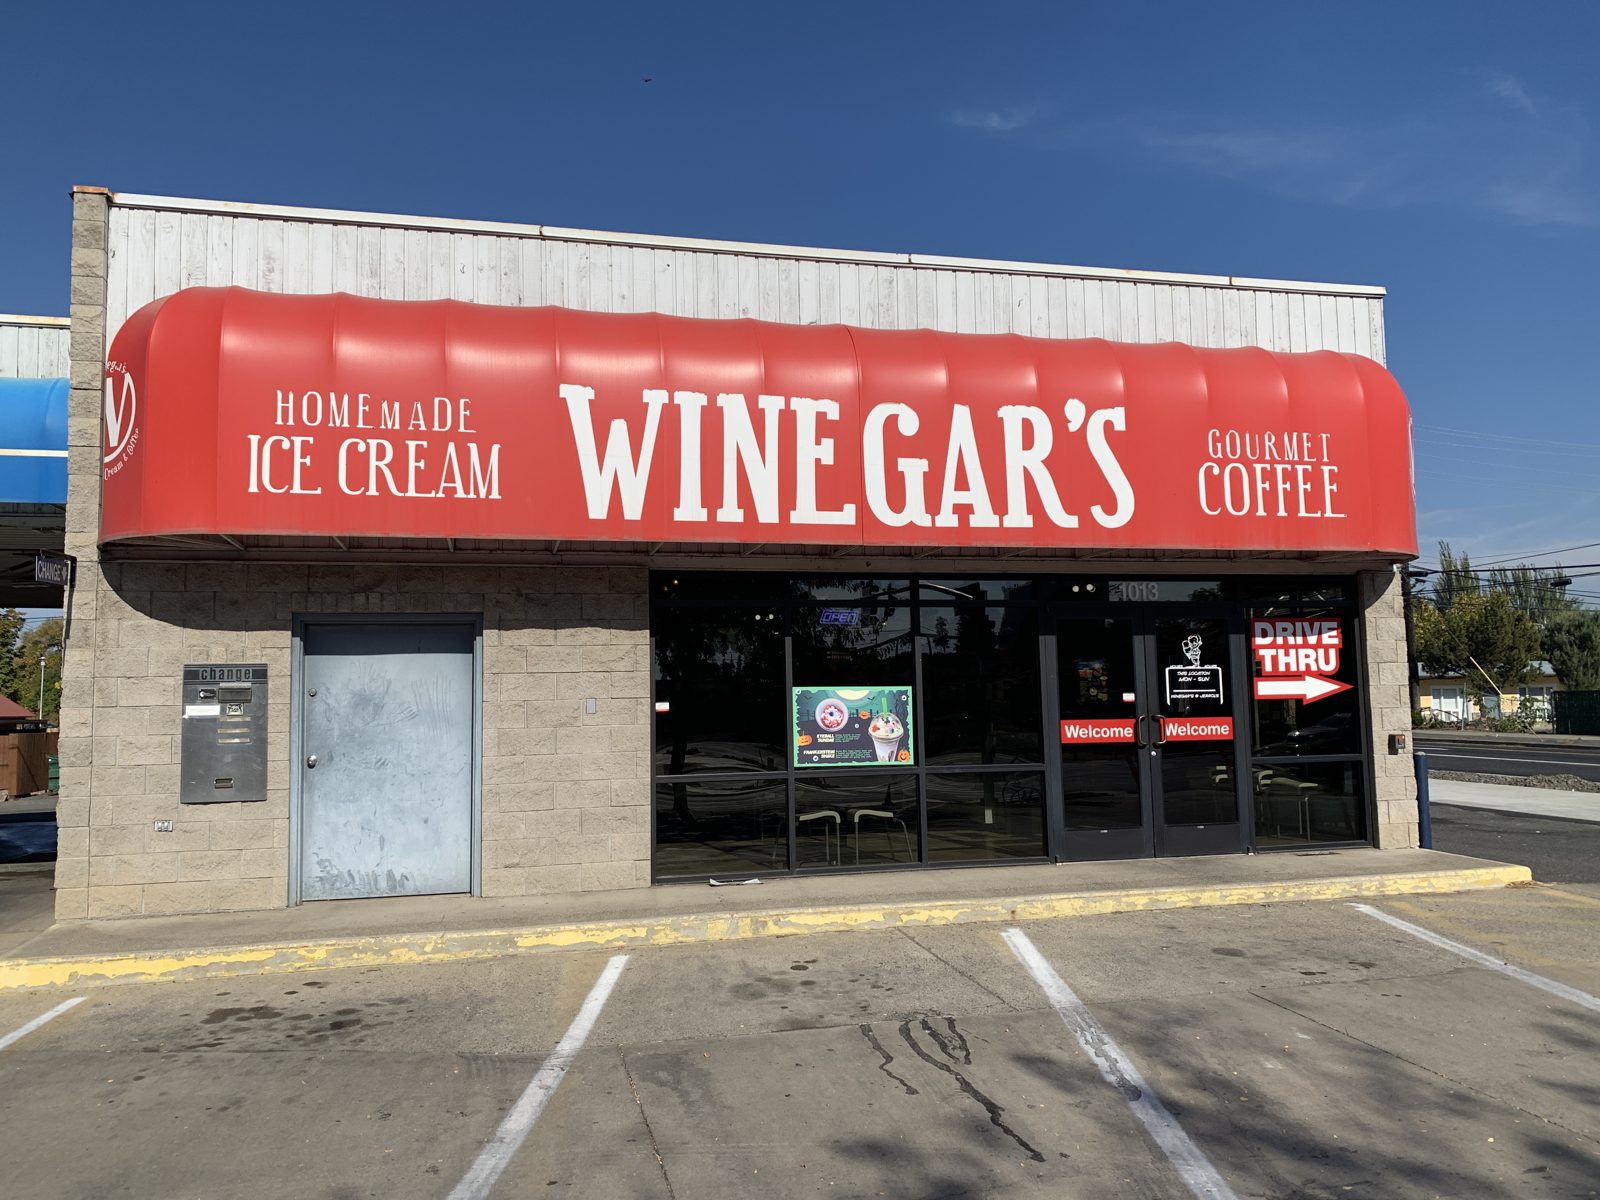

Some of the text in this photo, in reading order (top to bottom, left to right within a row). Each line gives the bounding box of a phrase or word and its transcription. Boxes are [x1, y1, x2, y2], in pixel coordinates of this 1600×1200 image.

[275, 390, 476, 433] HOMEMADE
[559, 383, 1135, 528] WINEGAR'S
[1208, 428, 1331, 462] GOURMET
[247, 434, 502, 500] ICE CREAM
[1198, 462, 1347, 518] COFFEE
[37, 560, 61, 581] CHANGE
[1119, 581, 1159, 601] 1013
[1254, 621, 1339, 645] DRIVE
[1258, 648, 1337, 672] THRU
[201, 667, 252, 682] change
[1064, 723, 1133, 739] Welcome
[1165, 723, 1230, 737] Welcome
